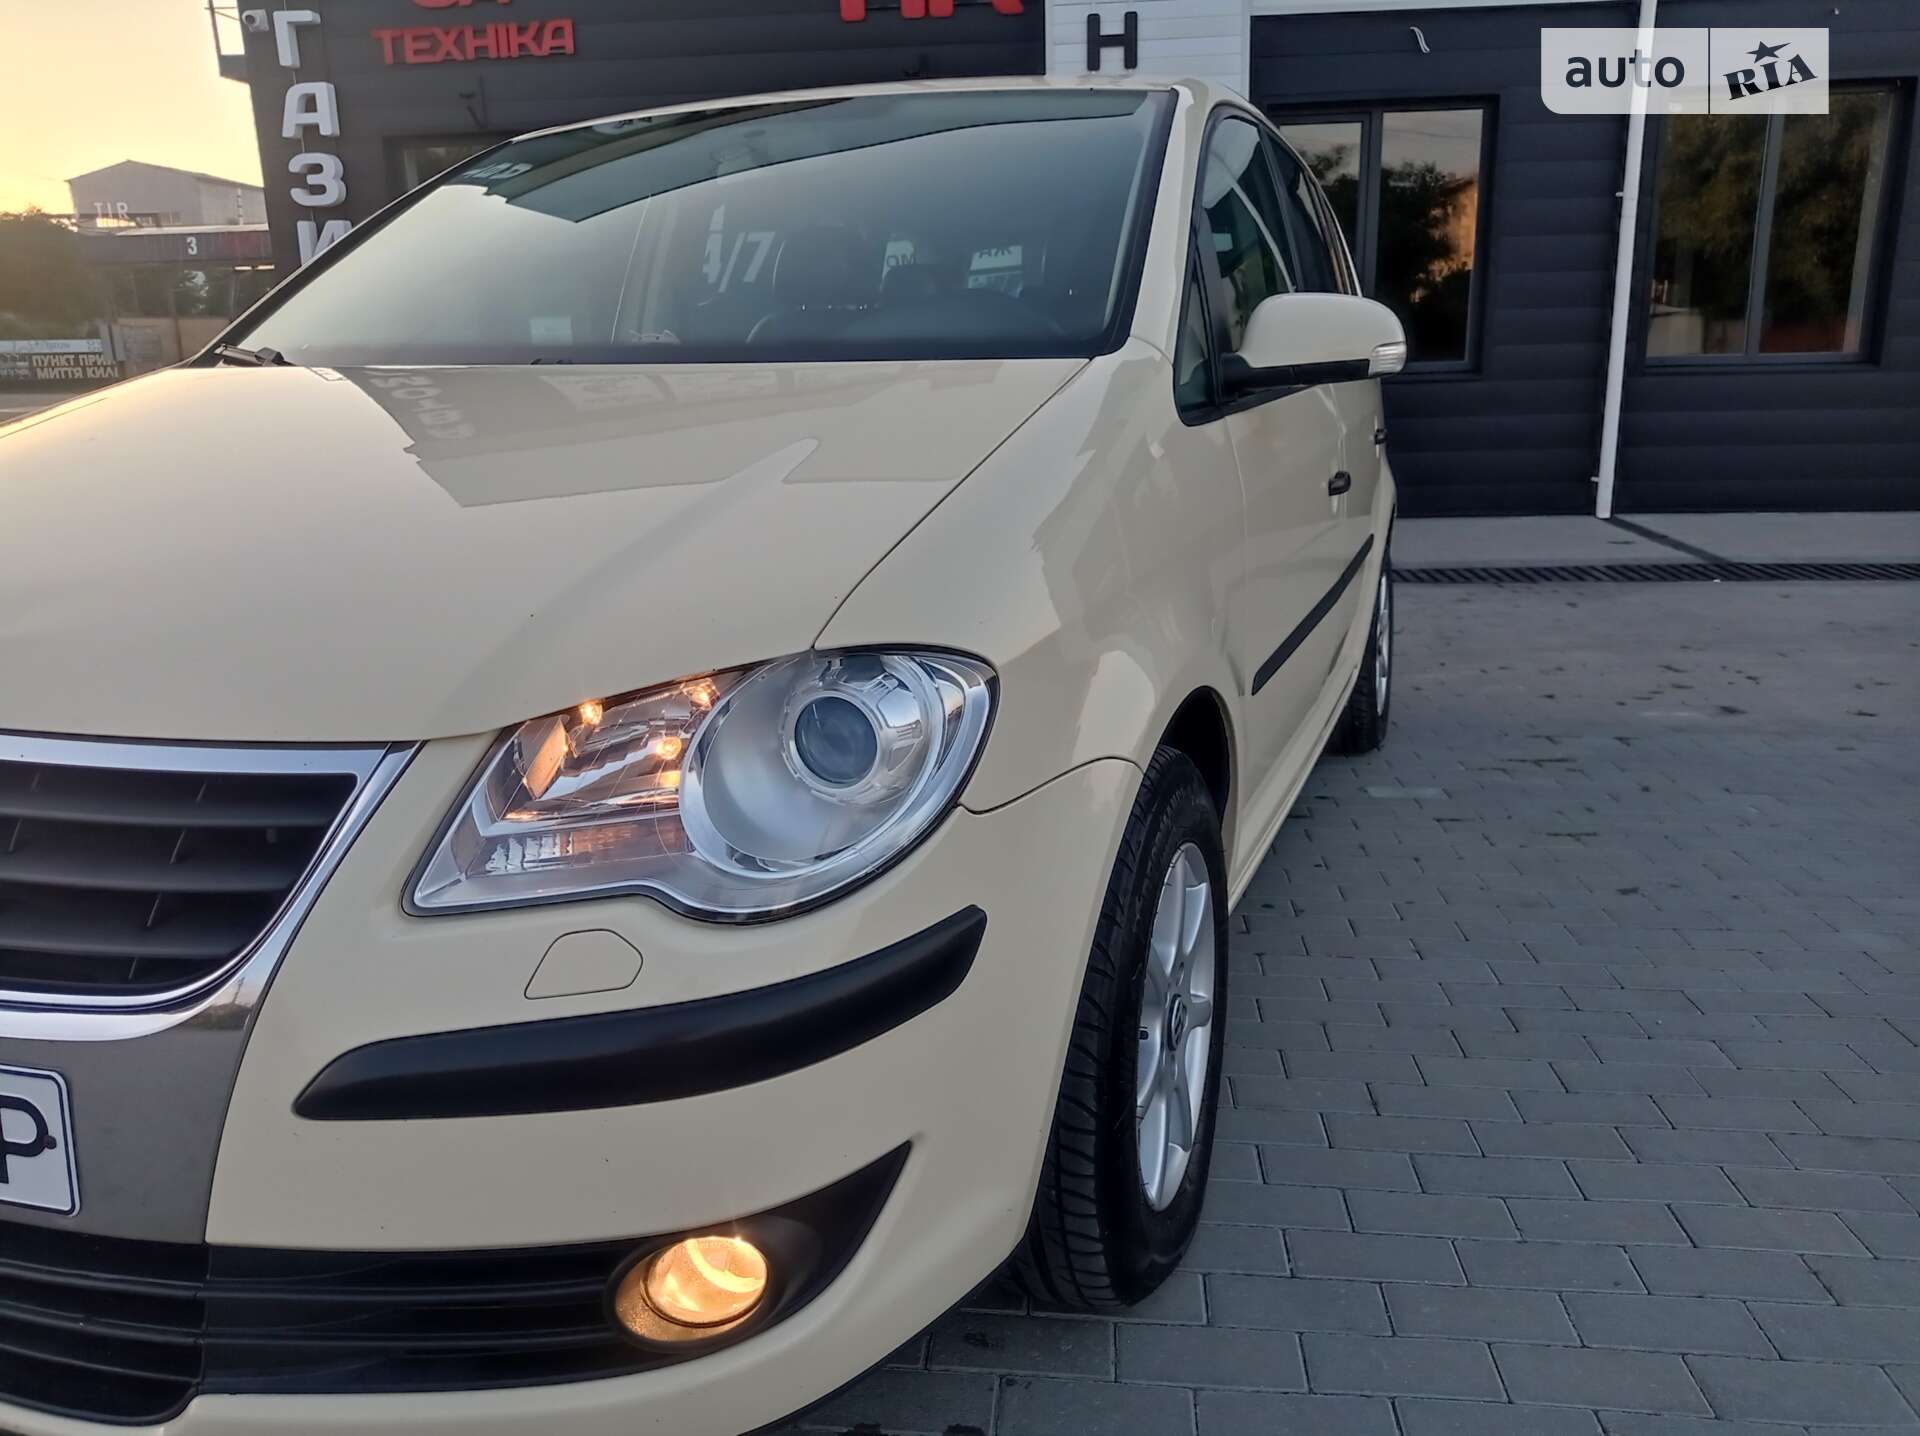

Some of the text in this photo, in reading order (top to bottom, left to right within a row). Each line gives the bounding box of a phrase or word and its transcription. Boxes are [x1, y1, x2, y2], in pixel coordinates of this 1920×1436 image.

[371, 19, 575, 65] ТЕХНІКА
[94, 202, 128, 219] TIR
[186, 236, 198, 255] 3
[31, 354, 75, 367] ПУНКТ
[36, 366, 83, 379] МИТТЯ
